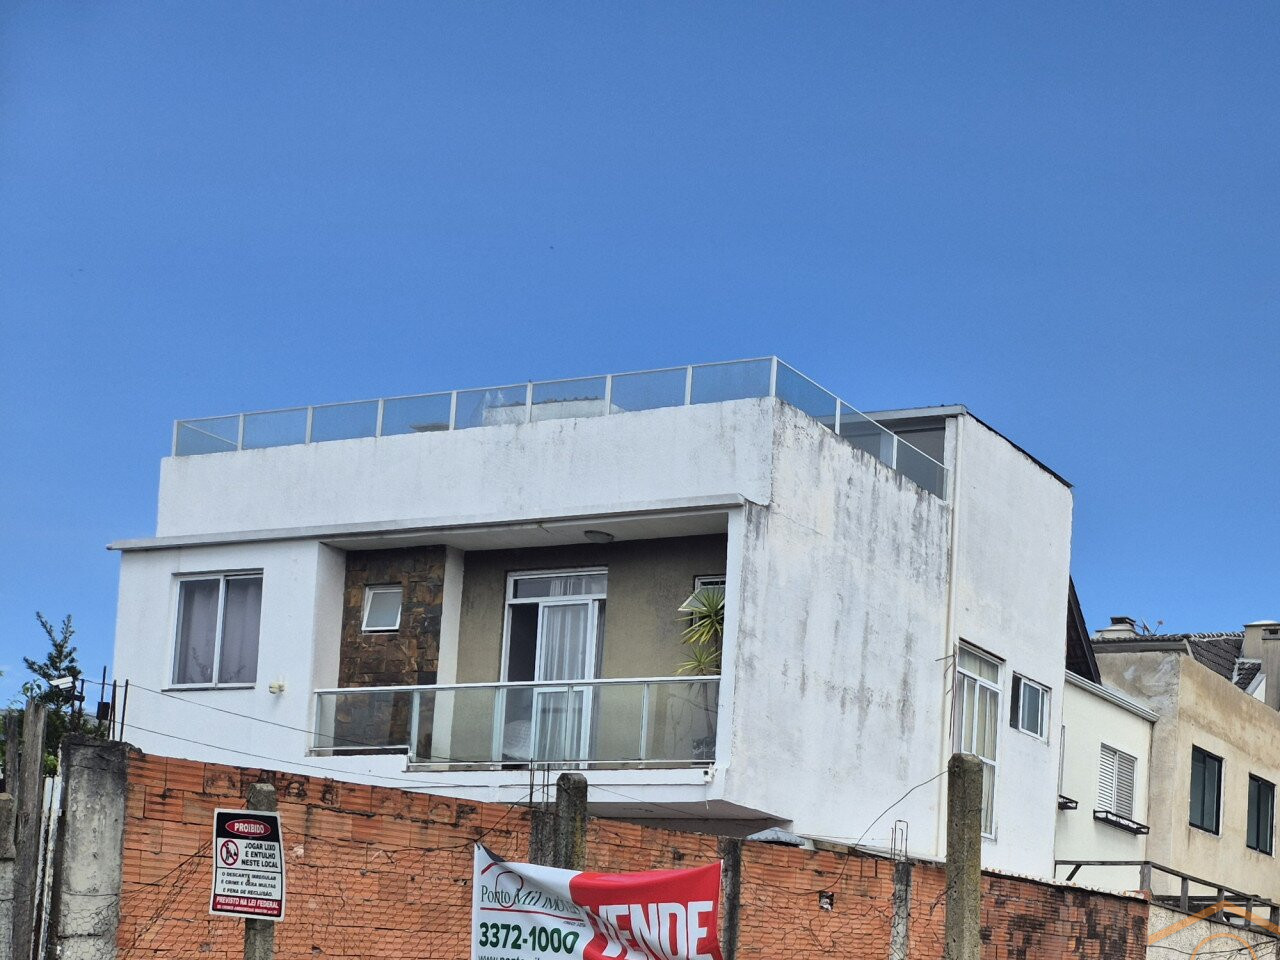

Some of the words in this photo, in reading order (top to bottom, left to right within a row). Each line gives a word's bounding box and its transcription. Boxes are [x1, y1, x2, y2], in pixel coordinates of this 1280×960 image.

[235, 823, 265, 834] PROIBIDO
[245, 843, 263, 851] JOGAR
[251, 852, 276, 860] ENTULHO
[242, 859, 260, 867] NESTE
[481, 885, 511, 903] Ponto
[514, 889, 542, 906] Mil
[479, 922, 579, 954] 3372-1000
